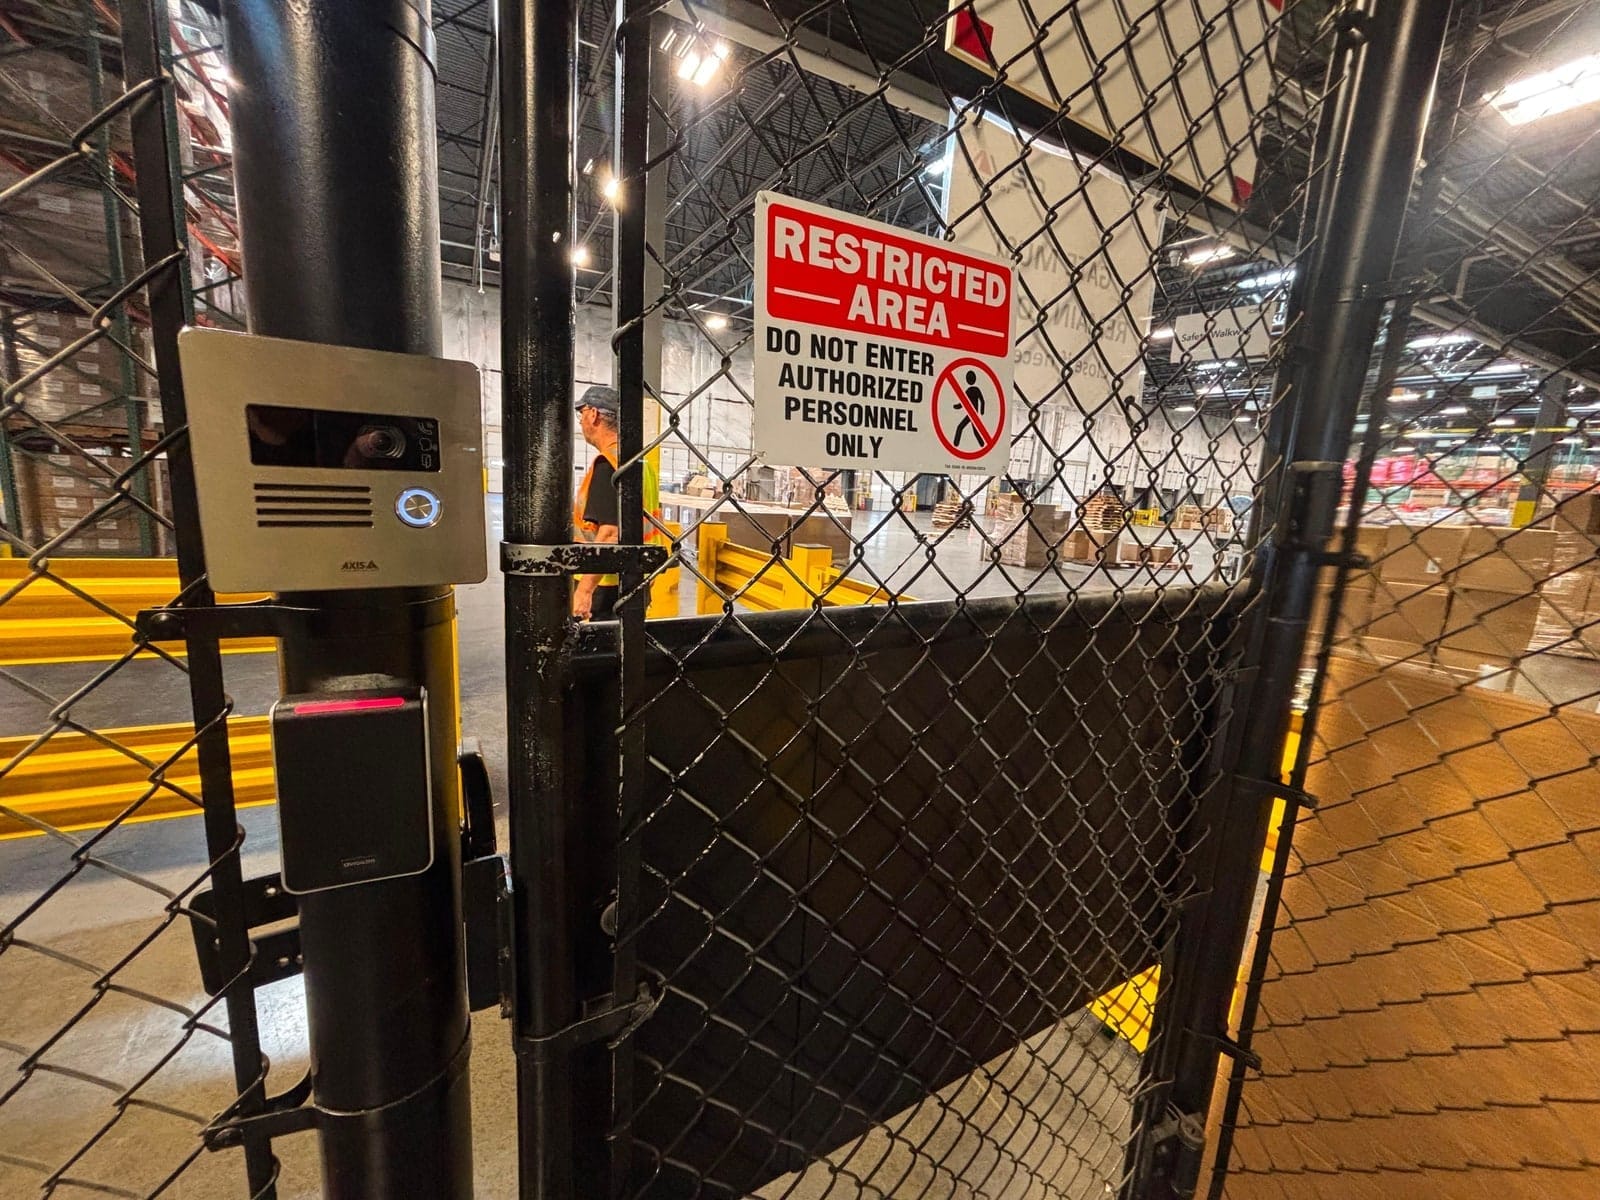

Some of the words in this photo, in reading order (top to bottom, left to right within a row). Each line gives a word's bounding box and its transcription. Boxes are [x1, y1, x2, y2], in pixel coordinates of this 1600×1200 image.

[774, 215, 1007, 308] RESTRICTED
[847, 284, 950, 338] AREA
[766, 326, 801, 356] DO
[810, 334, 858, 364] NOT
[866, 342, 935, 376] ENTER
[1181, 331, 1204, 342] Safet
[1211, 327, 1244, 338] Walkw
[778, 363, 923, 403] AUTHORIZED
[784, 397, 918, 432] PERSONNEL
[826, 432, 883, 459] ONLY
[341, 560, 367, 570] AXIS
